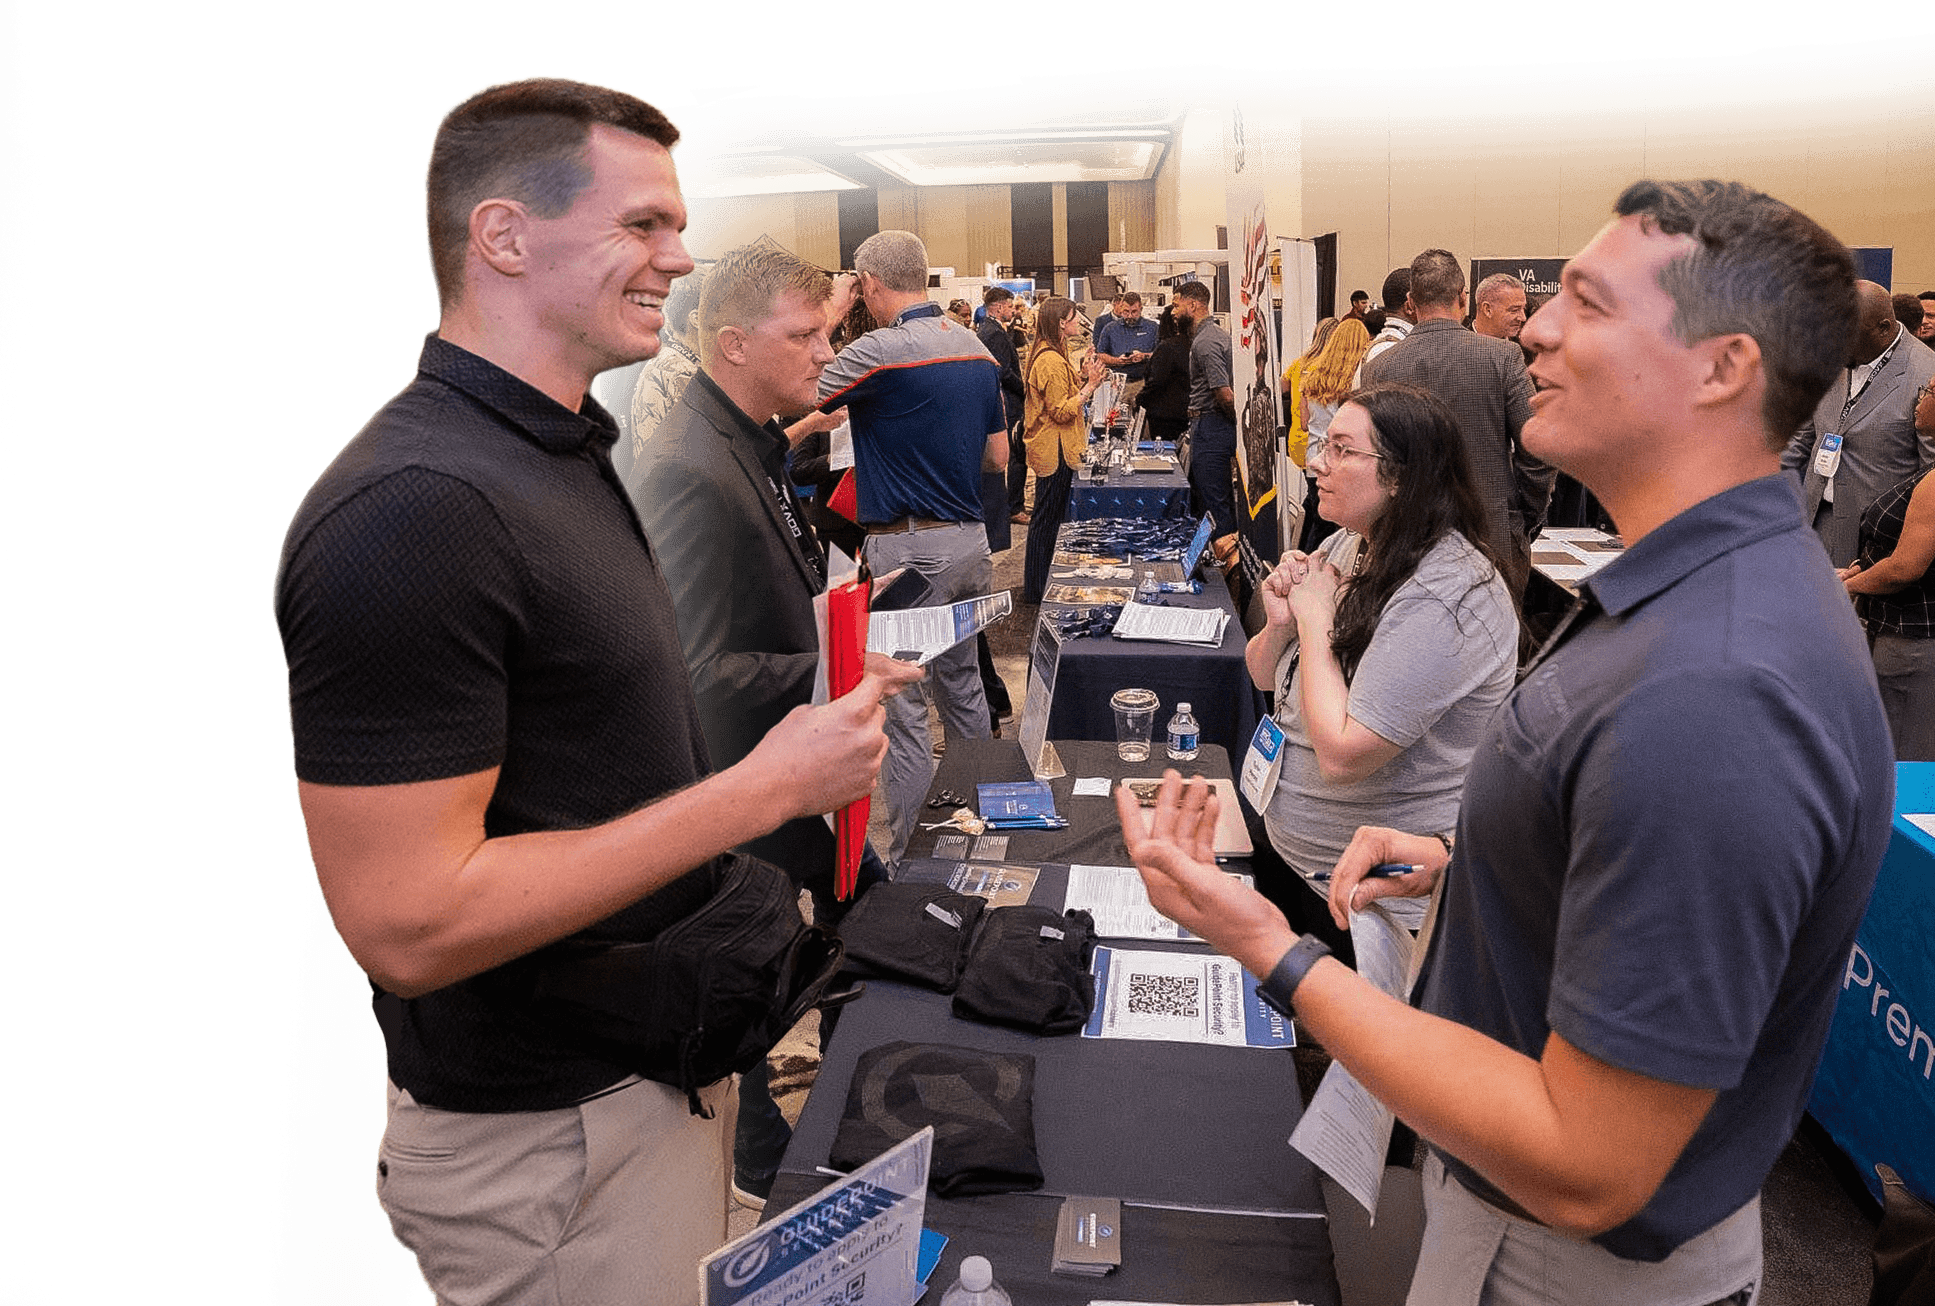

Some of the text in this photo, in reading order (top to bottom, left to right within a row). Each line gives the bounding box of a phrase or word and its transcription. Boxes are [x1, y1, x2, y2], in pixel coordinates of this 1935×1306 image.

[1519, 268, 1536, 281] VA
[1525, 281, 1562, 293] isabilit
[782, 502, 802, 538] GOVX
[1210, 963, 1224, 1036] GuidePoint Security?
[1268, 1005, 1285, 1039] POINT
